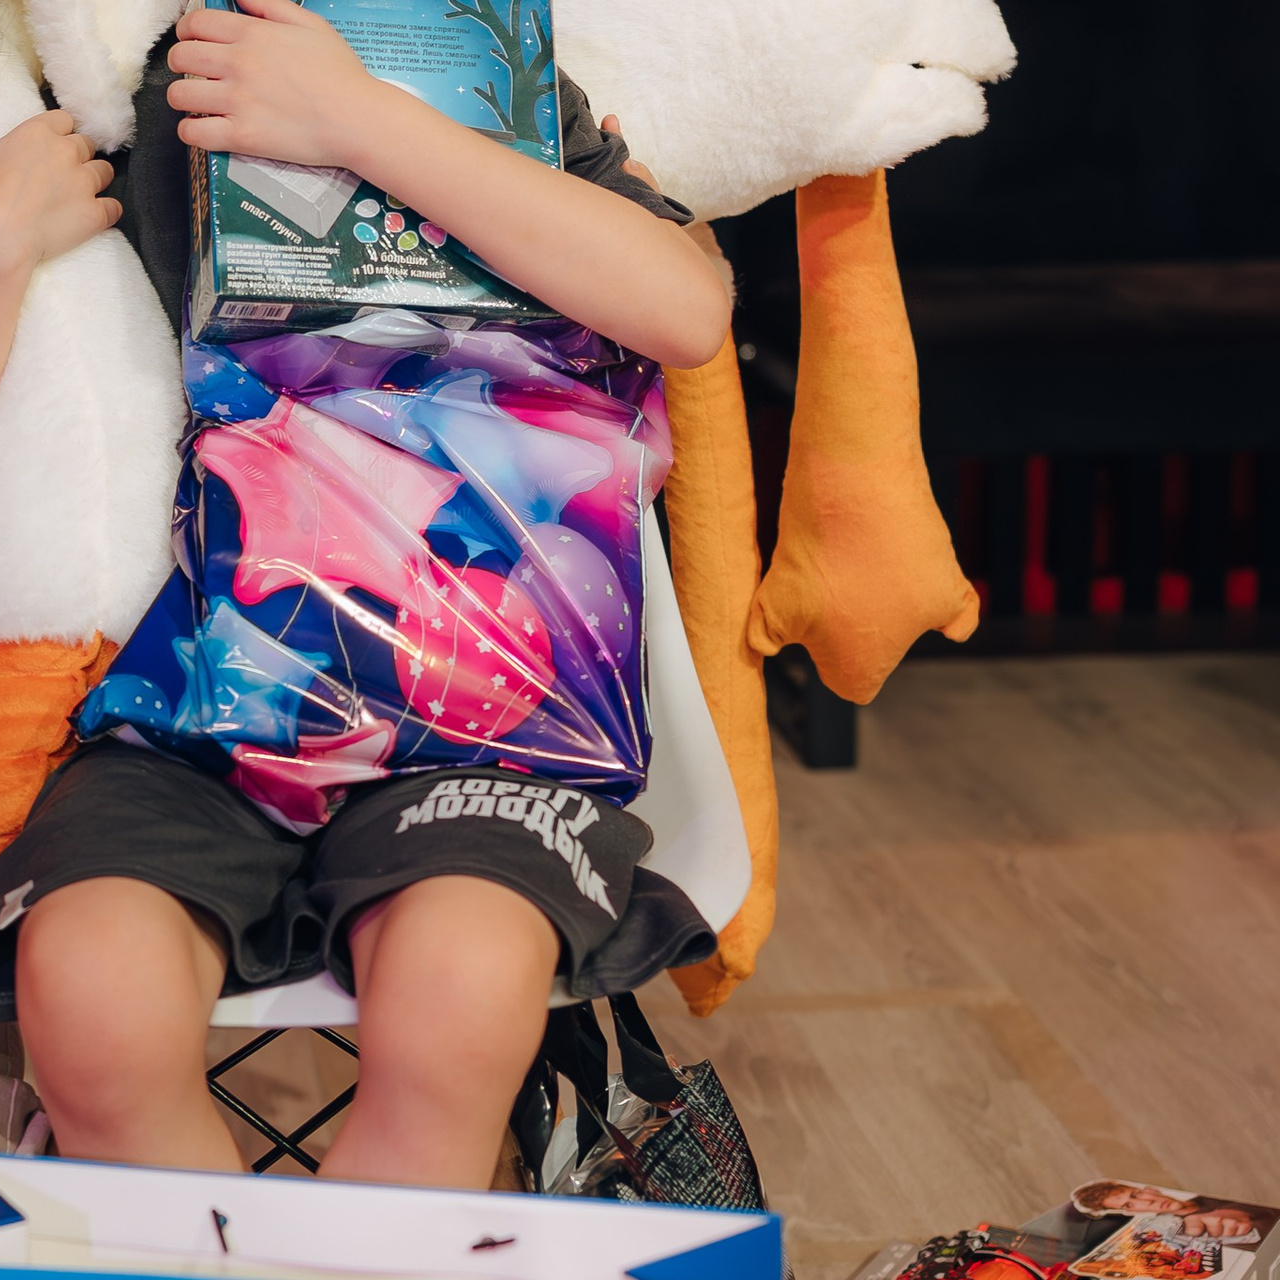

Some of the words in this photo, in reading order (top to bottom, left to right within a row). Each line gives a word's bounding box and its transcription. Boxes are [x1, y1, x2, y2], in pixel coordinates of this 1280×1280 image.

[365, 22, 407, 30] старинном
[409, 24, 432, 32] замке
[434, 25, 471, 34] спрятаны
[424, 33, 460, 42] охраняют
[421, 41, 465, 51] обитающие
[422, 49, 443, 57] Лишь
[421, 59, 452, 67] жутким
[240, 199, 271, 223] пласт
[269, 218, 302, 245] грунта
[226, 241, 254, 249] Возьми
[255, 243, 302, 254] инструменты
[262, 252, 281, 260] грунт
[380, 252, 428, 266] больших
[263, 259, 305, 268] фрагменты
[361, 264, 374, 275] 10
[410, 268, 447, 279] камней
[424, 778, 600, 837] ДОРОГУ
[395, 793, 618, 921] МОЛОДЫМ
